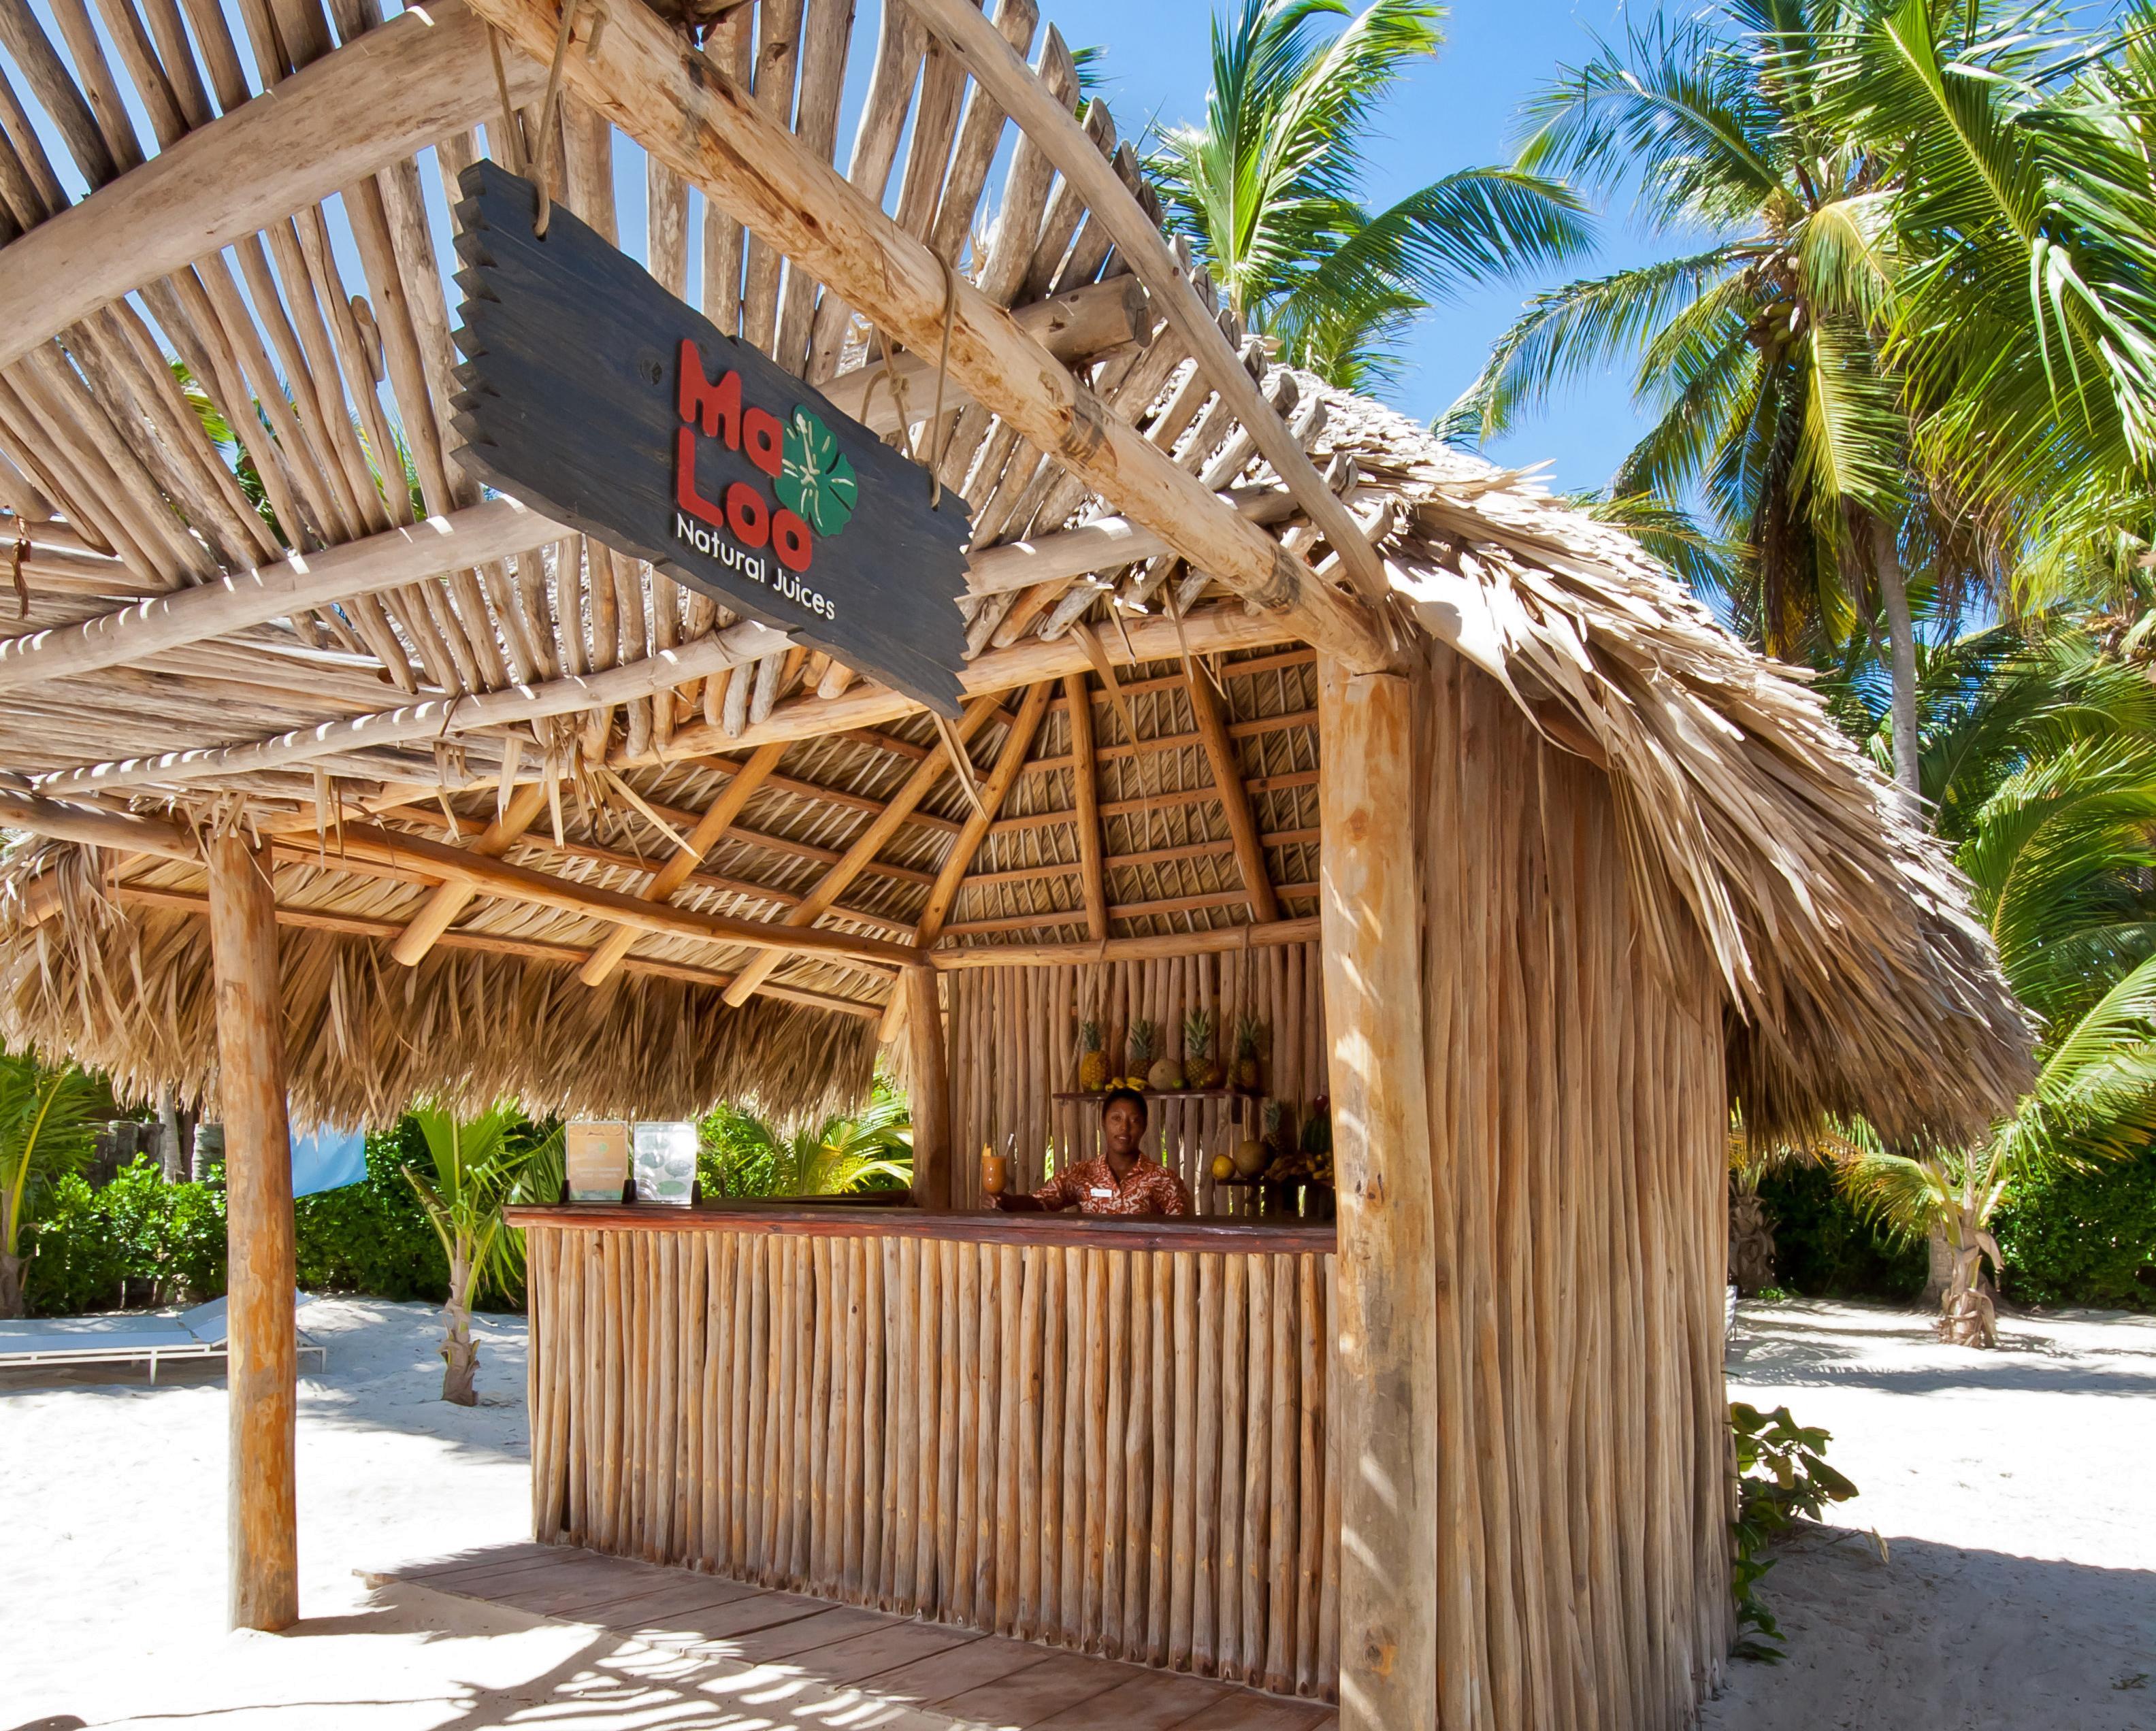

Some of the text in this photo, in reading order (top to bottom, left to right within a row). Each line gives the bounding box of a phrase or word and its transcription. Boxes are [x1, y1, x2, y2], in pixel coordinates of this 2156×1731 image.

[679, 339, 783, 478] Ma
[677, 513, 835, 621] Natural Juices
[678, 426, 812, 572] Loo
